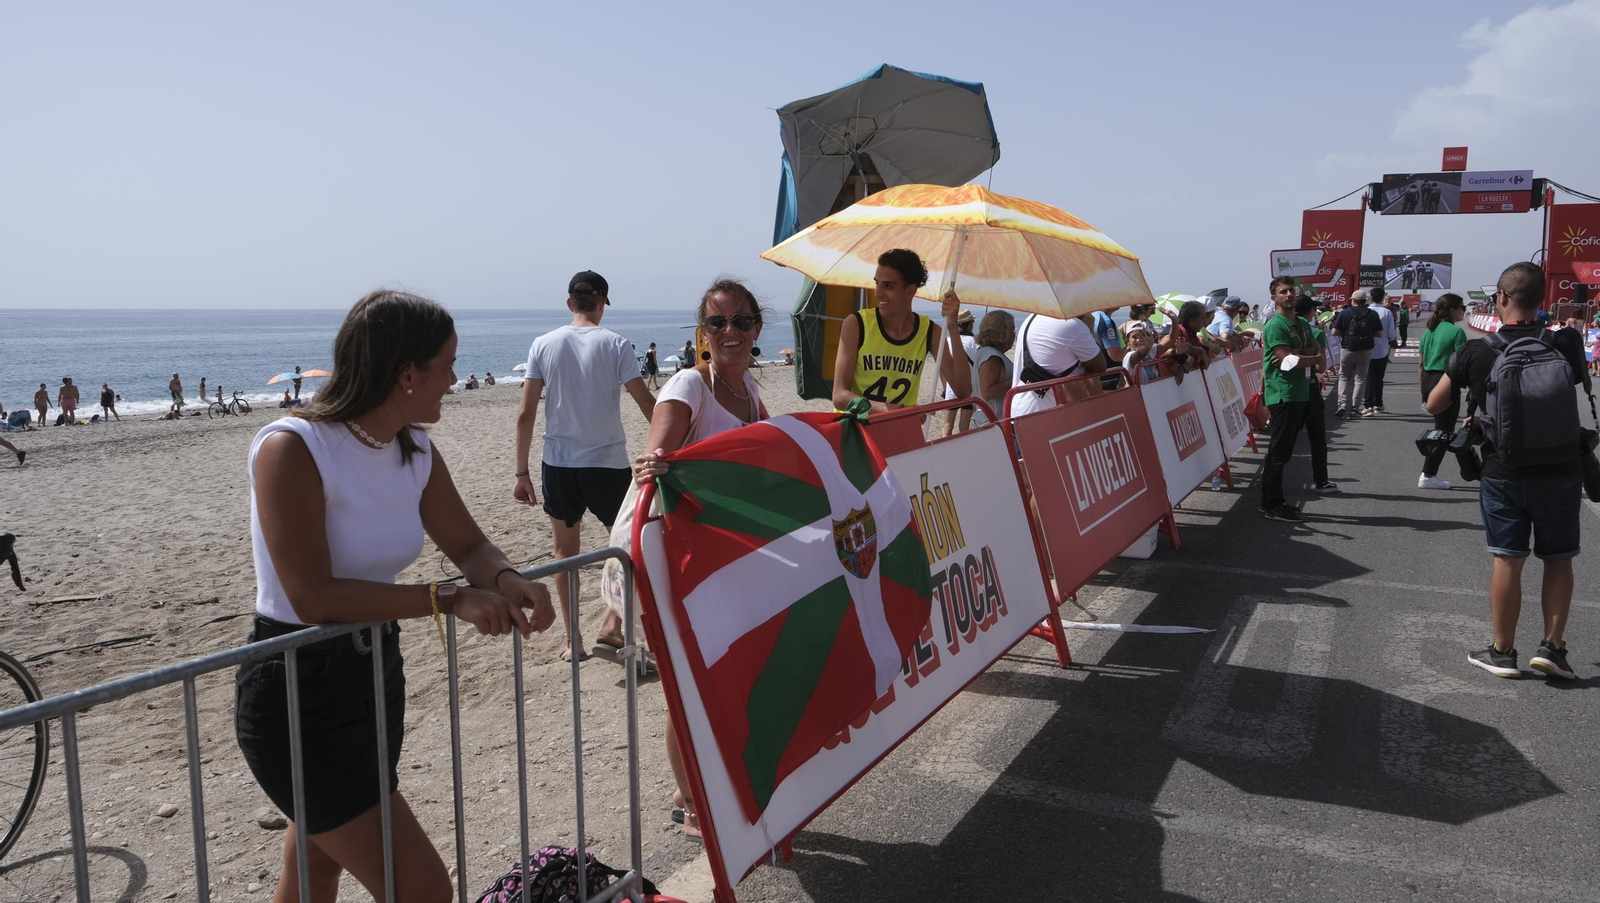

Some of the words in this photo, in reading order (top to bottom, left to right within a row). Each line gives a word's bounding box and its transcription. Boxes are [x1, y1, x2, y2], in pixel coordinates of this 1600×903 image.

[1468, 177, 1506, 185] Carrefour
[1318, 240, 1355, 249] Cofidis
[1292, 261, 1316, 269] plenitude
[863, 376, 912, 405] 42
[1171, 418, 1186, 451] LA
[1179, 409, 1203, 449] VUELTA
[1065, 450, 1096, 512] LA
[1083, 431, 1138, 500] VUELTA
[910, 472, 966, 566] IÓN
[930, 543, 1008, 656] TOCA
